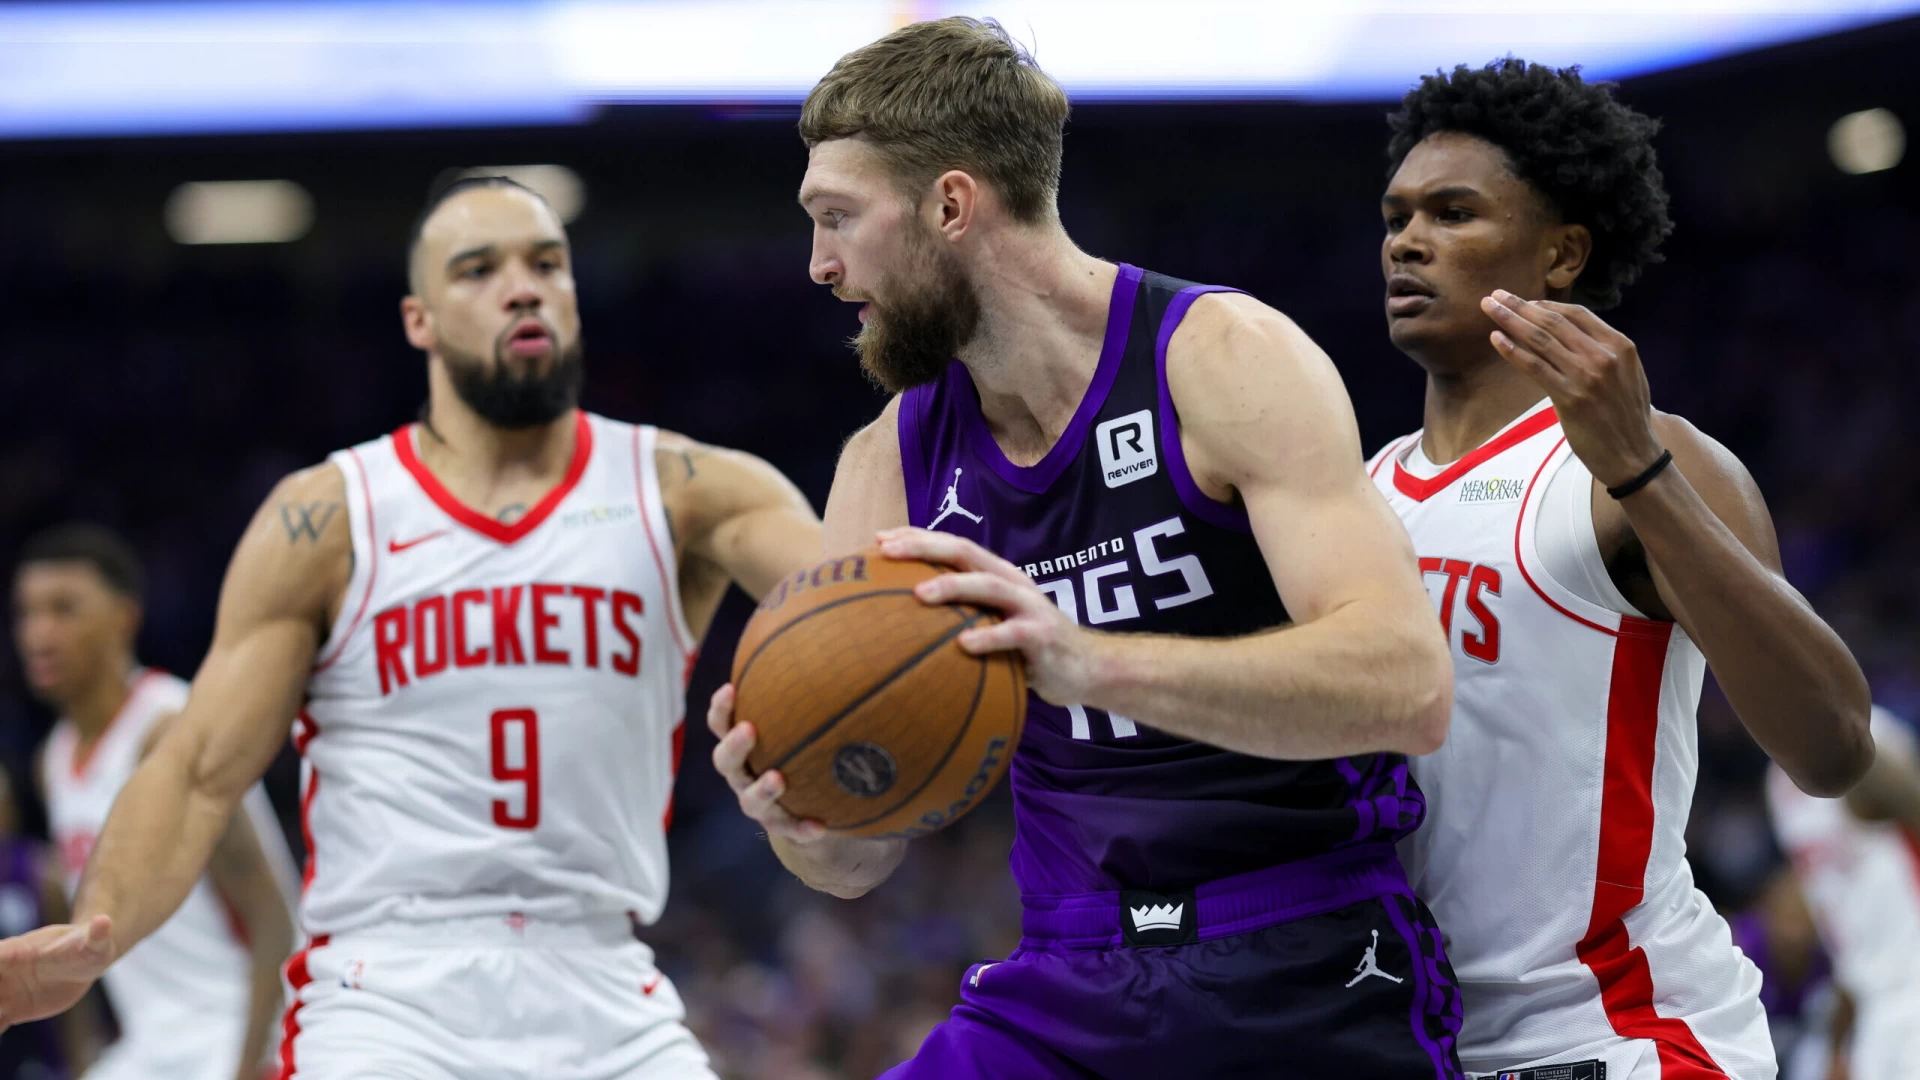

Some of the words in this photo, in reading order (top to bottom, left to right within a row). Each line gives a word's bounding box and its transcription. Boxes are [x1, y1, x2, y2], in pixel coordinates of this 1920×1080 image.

[1110, 422, 1144, 461] R
[1107, 458, 1154, 481] REVIVER
[1461, 478, 1525, 492] MEMORIAL
[1459, 487, 1522, 502] HERMANN
[1017, 537, 1125, 578] RAMENTO
[1036, 516, 1215, 626] NGS
[373, 583, 644, 697] ROCKETS
[490, 708, 541, 831] 9
